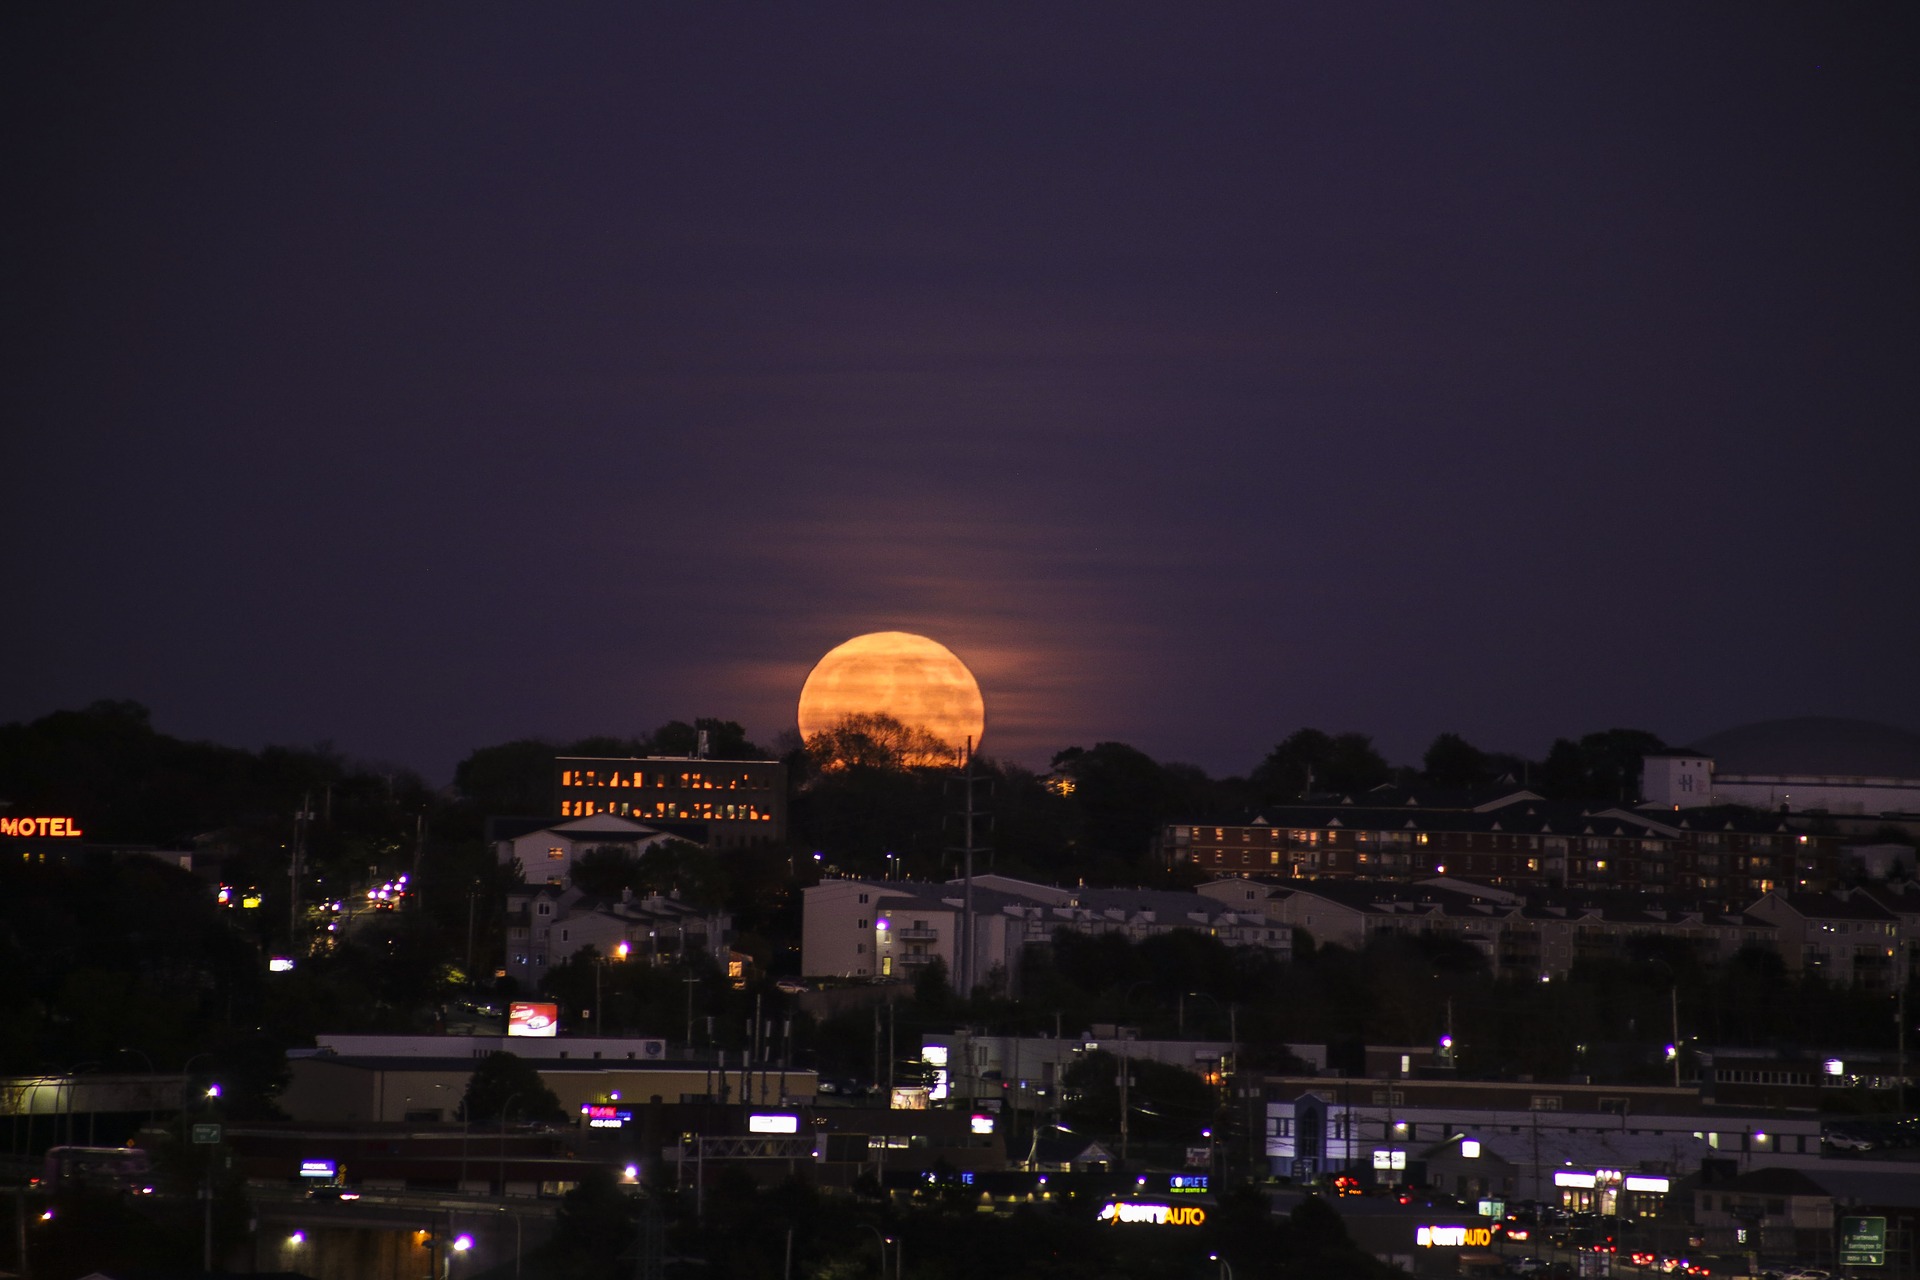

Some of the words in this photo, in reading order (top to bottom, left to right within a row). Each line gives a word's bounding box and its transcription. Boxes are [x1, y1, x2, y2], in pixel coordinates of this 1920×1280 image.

[0, 817, 82, 837] MOTEL
[1163, 1207, 1205, 1225] AUTO
[1462, 1228, 1490, 1246] AUTO
